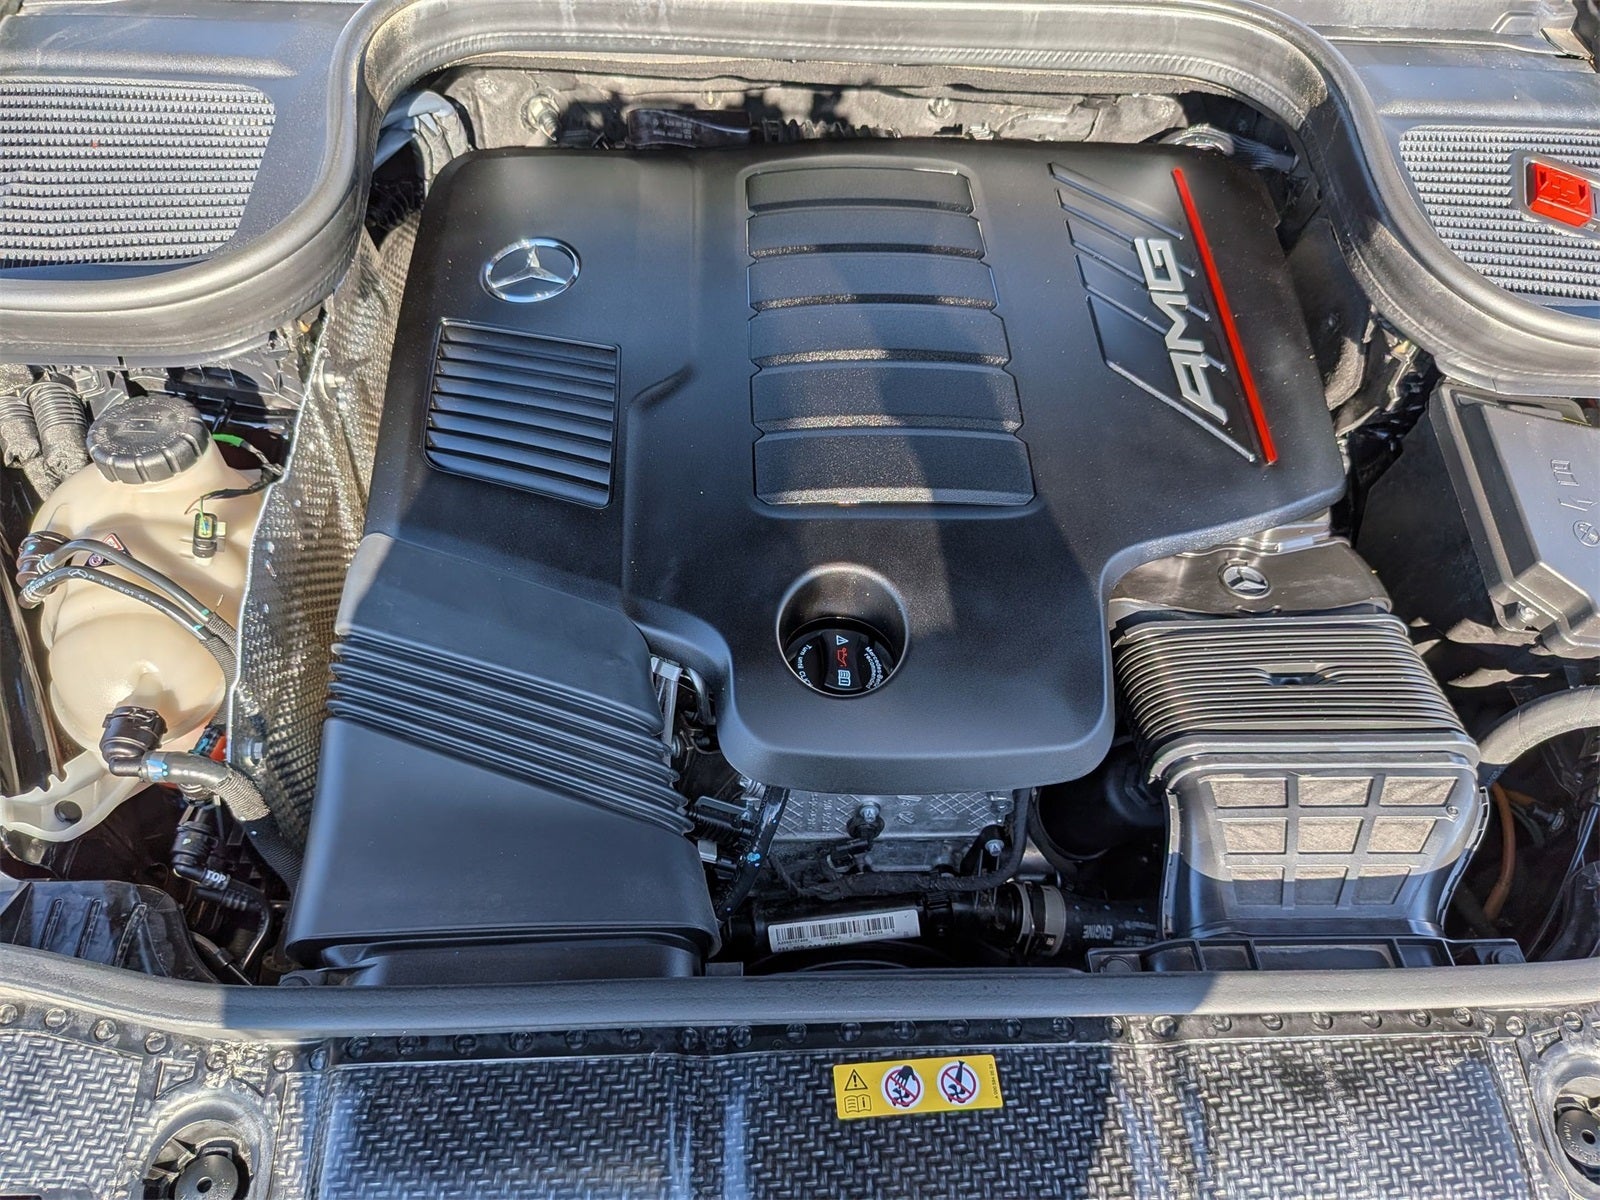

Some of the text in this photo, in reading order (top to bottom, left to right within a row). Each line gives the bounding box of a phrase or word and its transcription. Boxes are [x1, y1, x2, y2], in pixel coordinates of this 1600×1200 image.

[1134, 237, 1228, 425] AMG
[800, 644, 813, 656] Turn
[206, 869, 227, 883] TOP
[1082, 924, 1113, 940] ENGINE
